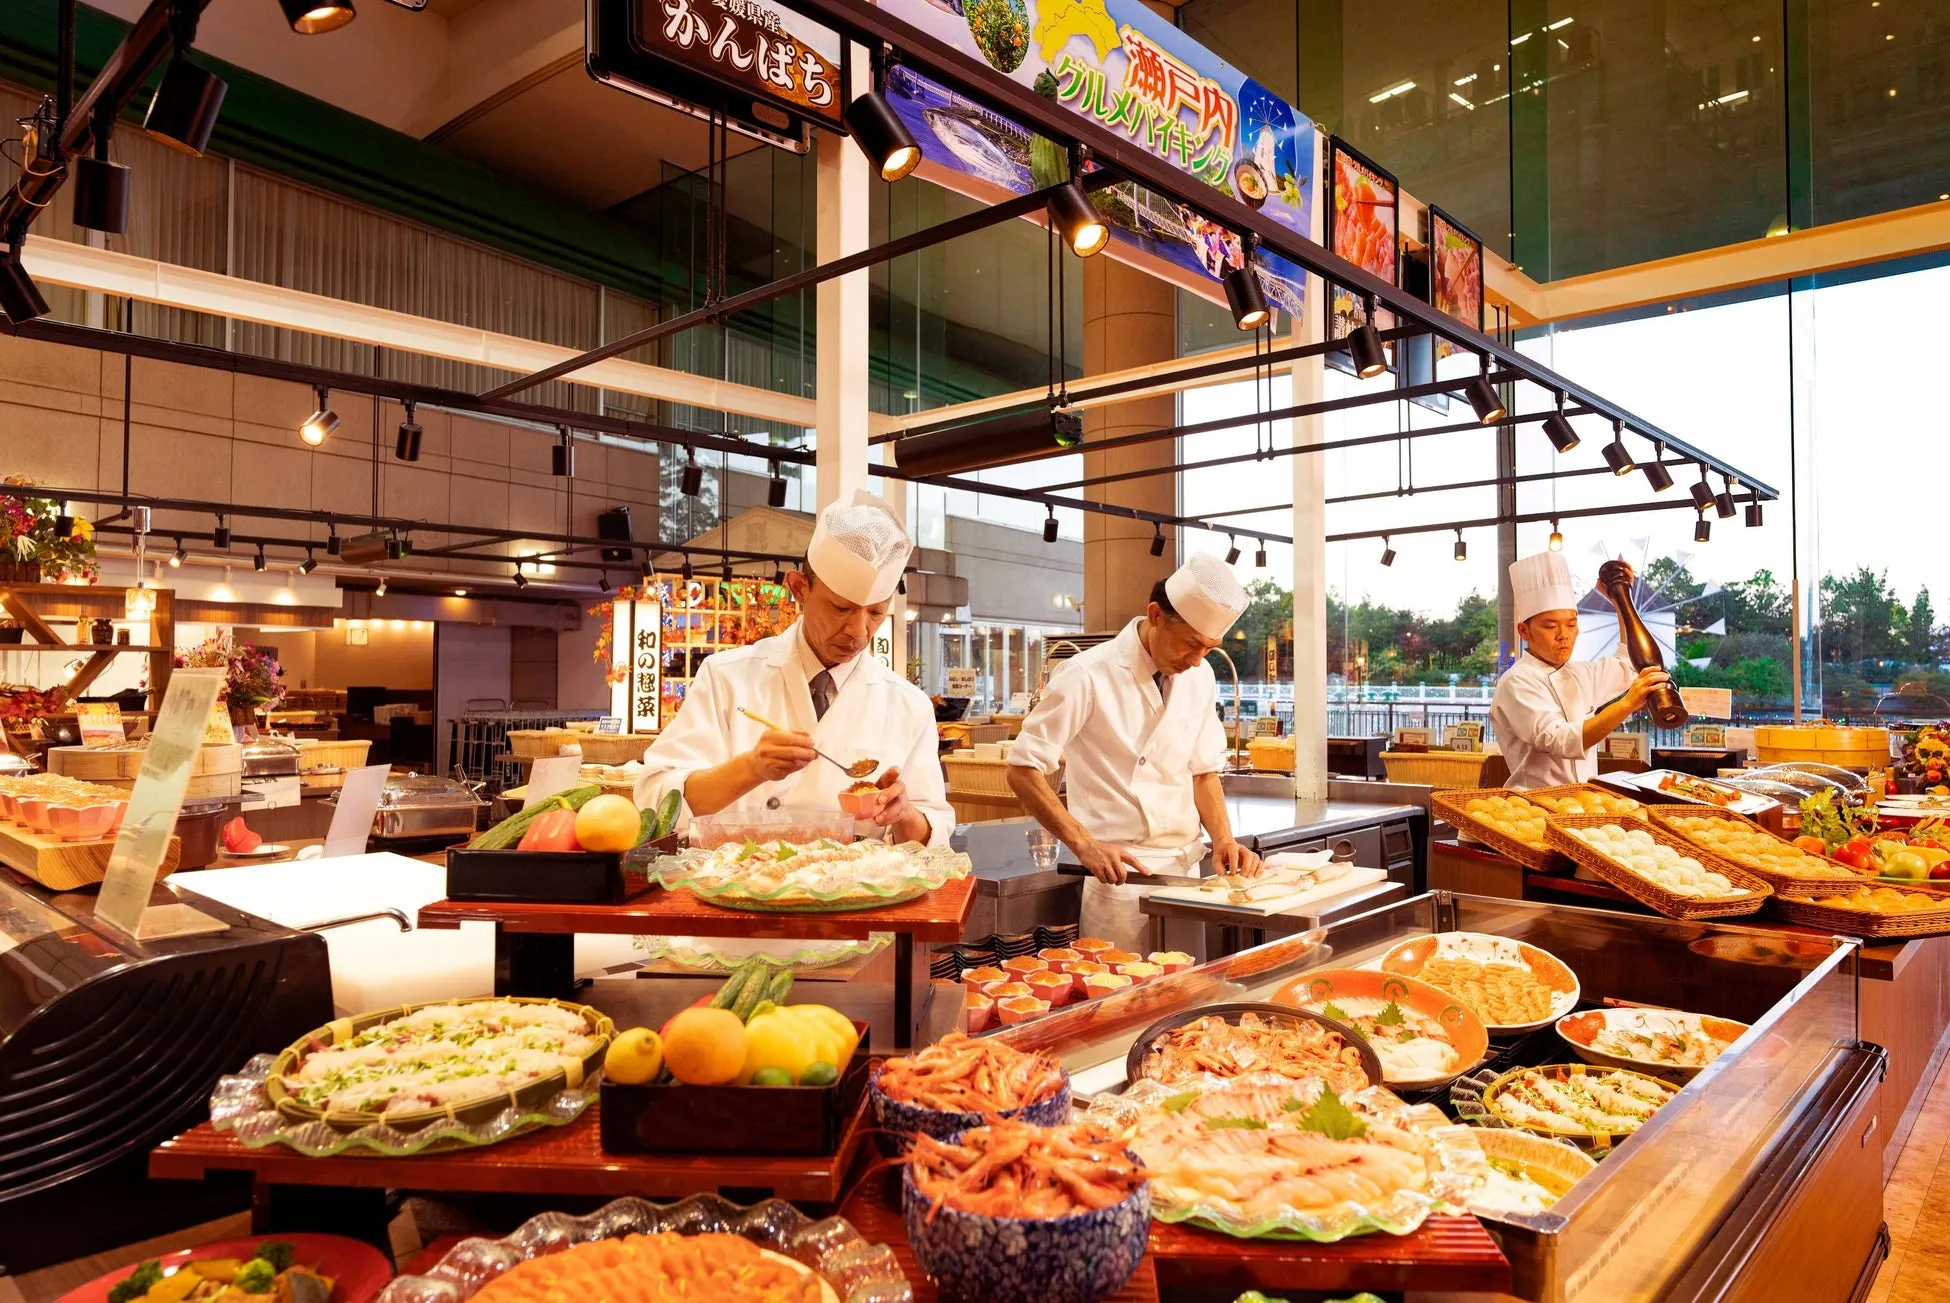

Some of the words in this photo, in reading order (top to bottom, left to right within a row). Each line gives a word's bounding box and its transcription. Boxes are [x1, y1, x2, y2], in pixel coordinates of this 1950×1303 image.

[662, 0, 833, 106] かんぱち
[1125, 33, 1235, 150] 瀬戸内
[1055, 54, 1231, 184] グルメバイキング
[637, 629, 657, 718] 和の惣菜
